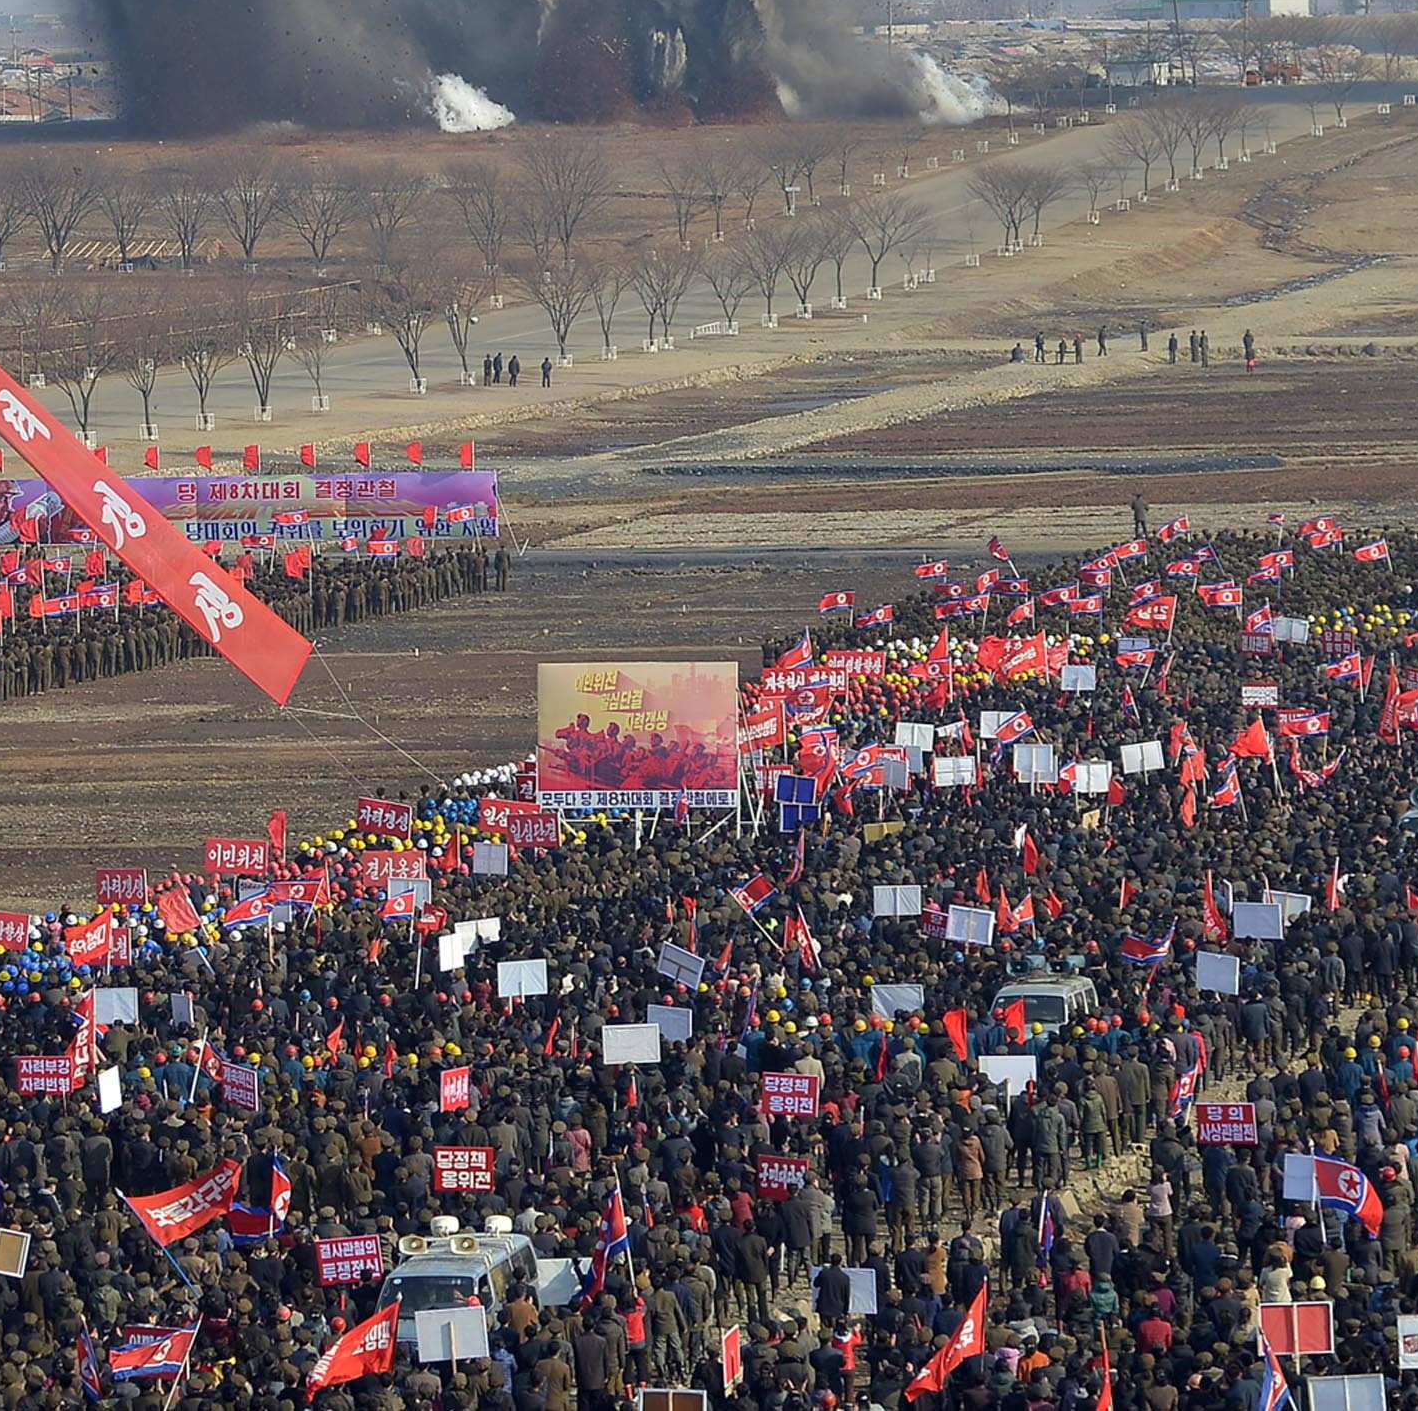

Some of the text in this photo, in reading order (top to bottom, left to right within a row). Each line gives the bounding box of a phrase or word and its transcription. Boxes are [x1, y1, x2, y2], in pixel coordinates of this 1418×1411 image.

[176, 479, 397, 503] 당 제8차대회 결정관철
[541, 792, 578, 808] 모두다
[580, 792, 593, 807] 당
[596, 791, 654, 807] 제8차대회
[358, 805, 409, 832] 자력갱생
[509, 816, 556, 842] 일심단결
[208, 843, 264, 870] 이민위천
[99, 873, 145, 899] 자력갱생
[20, 1059, 70, 1075] 자력부강
[20, 1077, 70, 1092] 자력번영
[765, 1076, 809, 1094] 당정책
[770, 1095, 814, 1115] 옹위전
[1200, 1123, 1255, 1143] 사상관철전
[436, 1150, 487, 1170] 당정책
[441, 1170, 491, 1190] 옹위전
